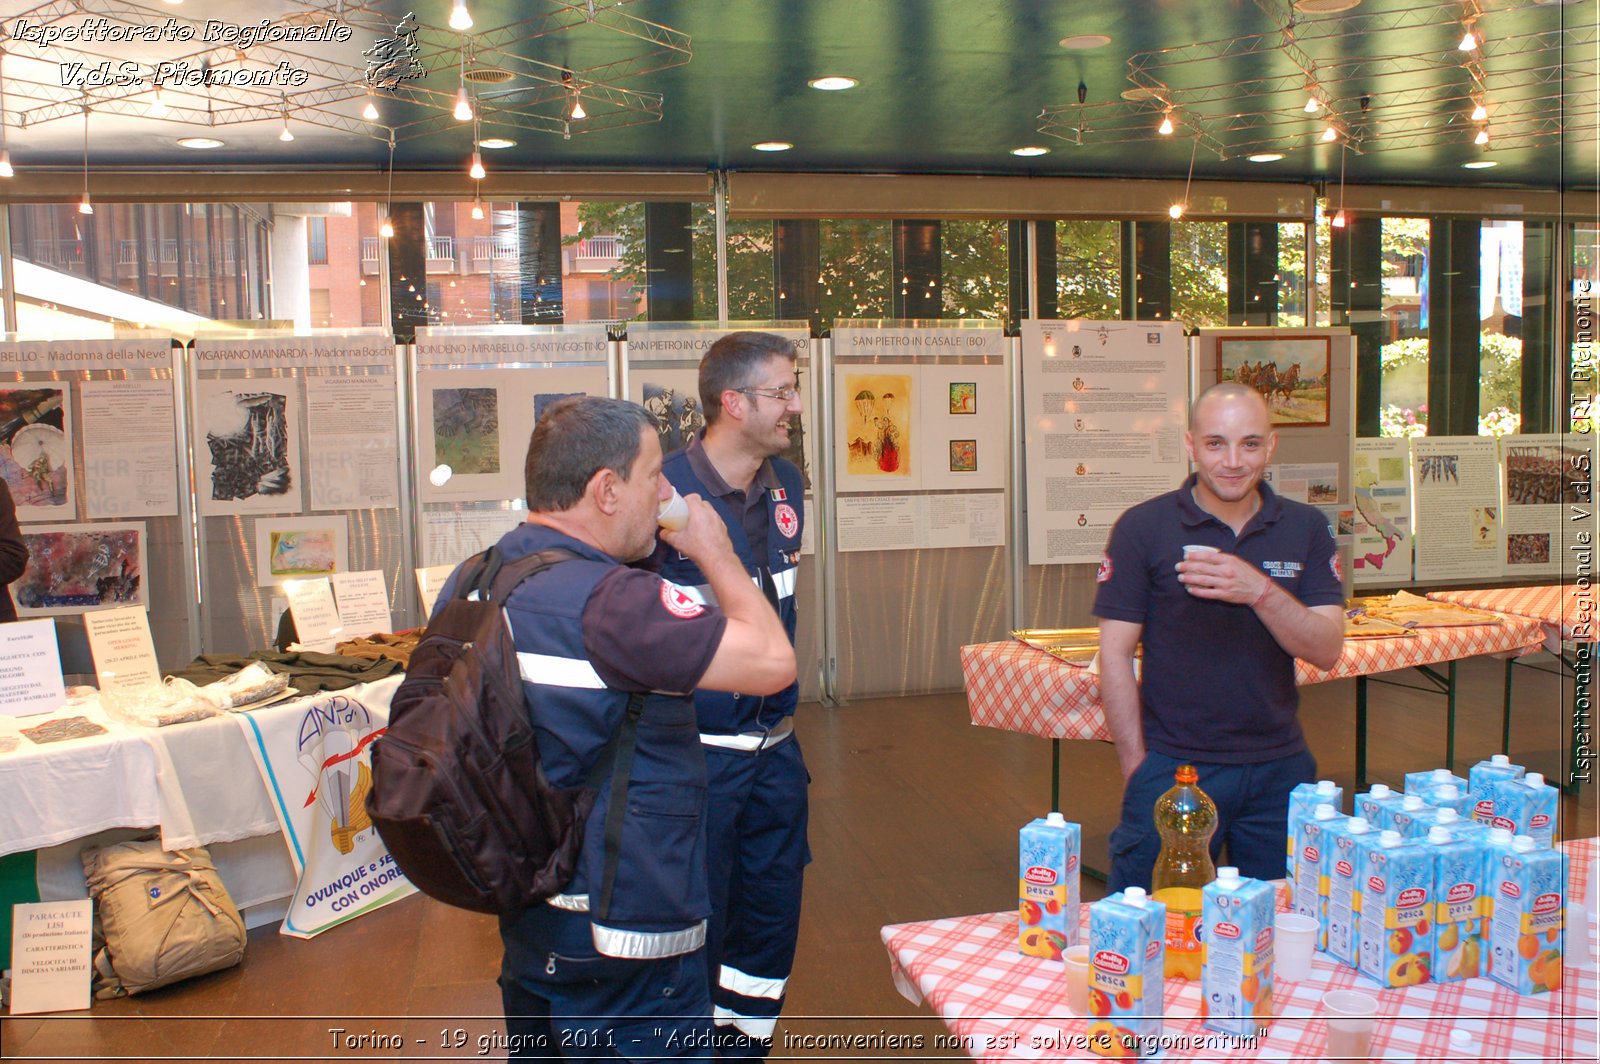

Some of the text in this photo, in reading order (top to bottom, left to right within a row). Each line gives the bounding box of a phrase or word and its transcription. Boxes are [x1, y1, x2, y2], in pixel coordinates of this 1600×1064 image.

[417, 344, 467, 354] BONDENO
[471, 342, 525, 353] MIRABELLO
[530, 341, 606, 353] SANT'AGOSTINO
[629, 340, 648, 351] SAN
[650, 340, 682, 350] PIETRO
[683, 340, 693, 350] IN
[695, 339, 714, 350] CAS
[853, 336, 986, 347] SAN PIETRO IN CASALE (BO)
[0, 351, 37, 362] BELLO
[48, 350, 103, 361] Madonna
[106, 349, 134, 360] della
[136, 349, 166, 360] Neve
[196, 349, 250, 361] VIGARANO
[251, 348, 308, 360] MAINARDA
[315, 347, 361, 358] Madonna
[362, 346, 393, 357] Boschi
[306, 854, 394, 909] OVUNQUE e SE
[330, 865, 404, 913] CON ONORE
[1026, 886, 1054, 896] pesca
[29, 910, 82, 921] PARACAUTE
[1397, 909, 1424, 921] pesca
[1449, 904, 1473, 915] pera
[25, 943, 84, 953] CARATTERISTICA
[1094, 972, 1126, 988] pesca
